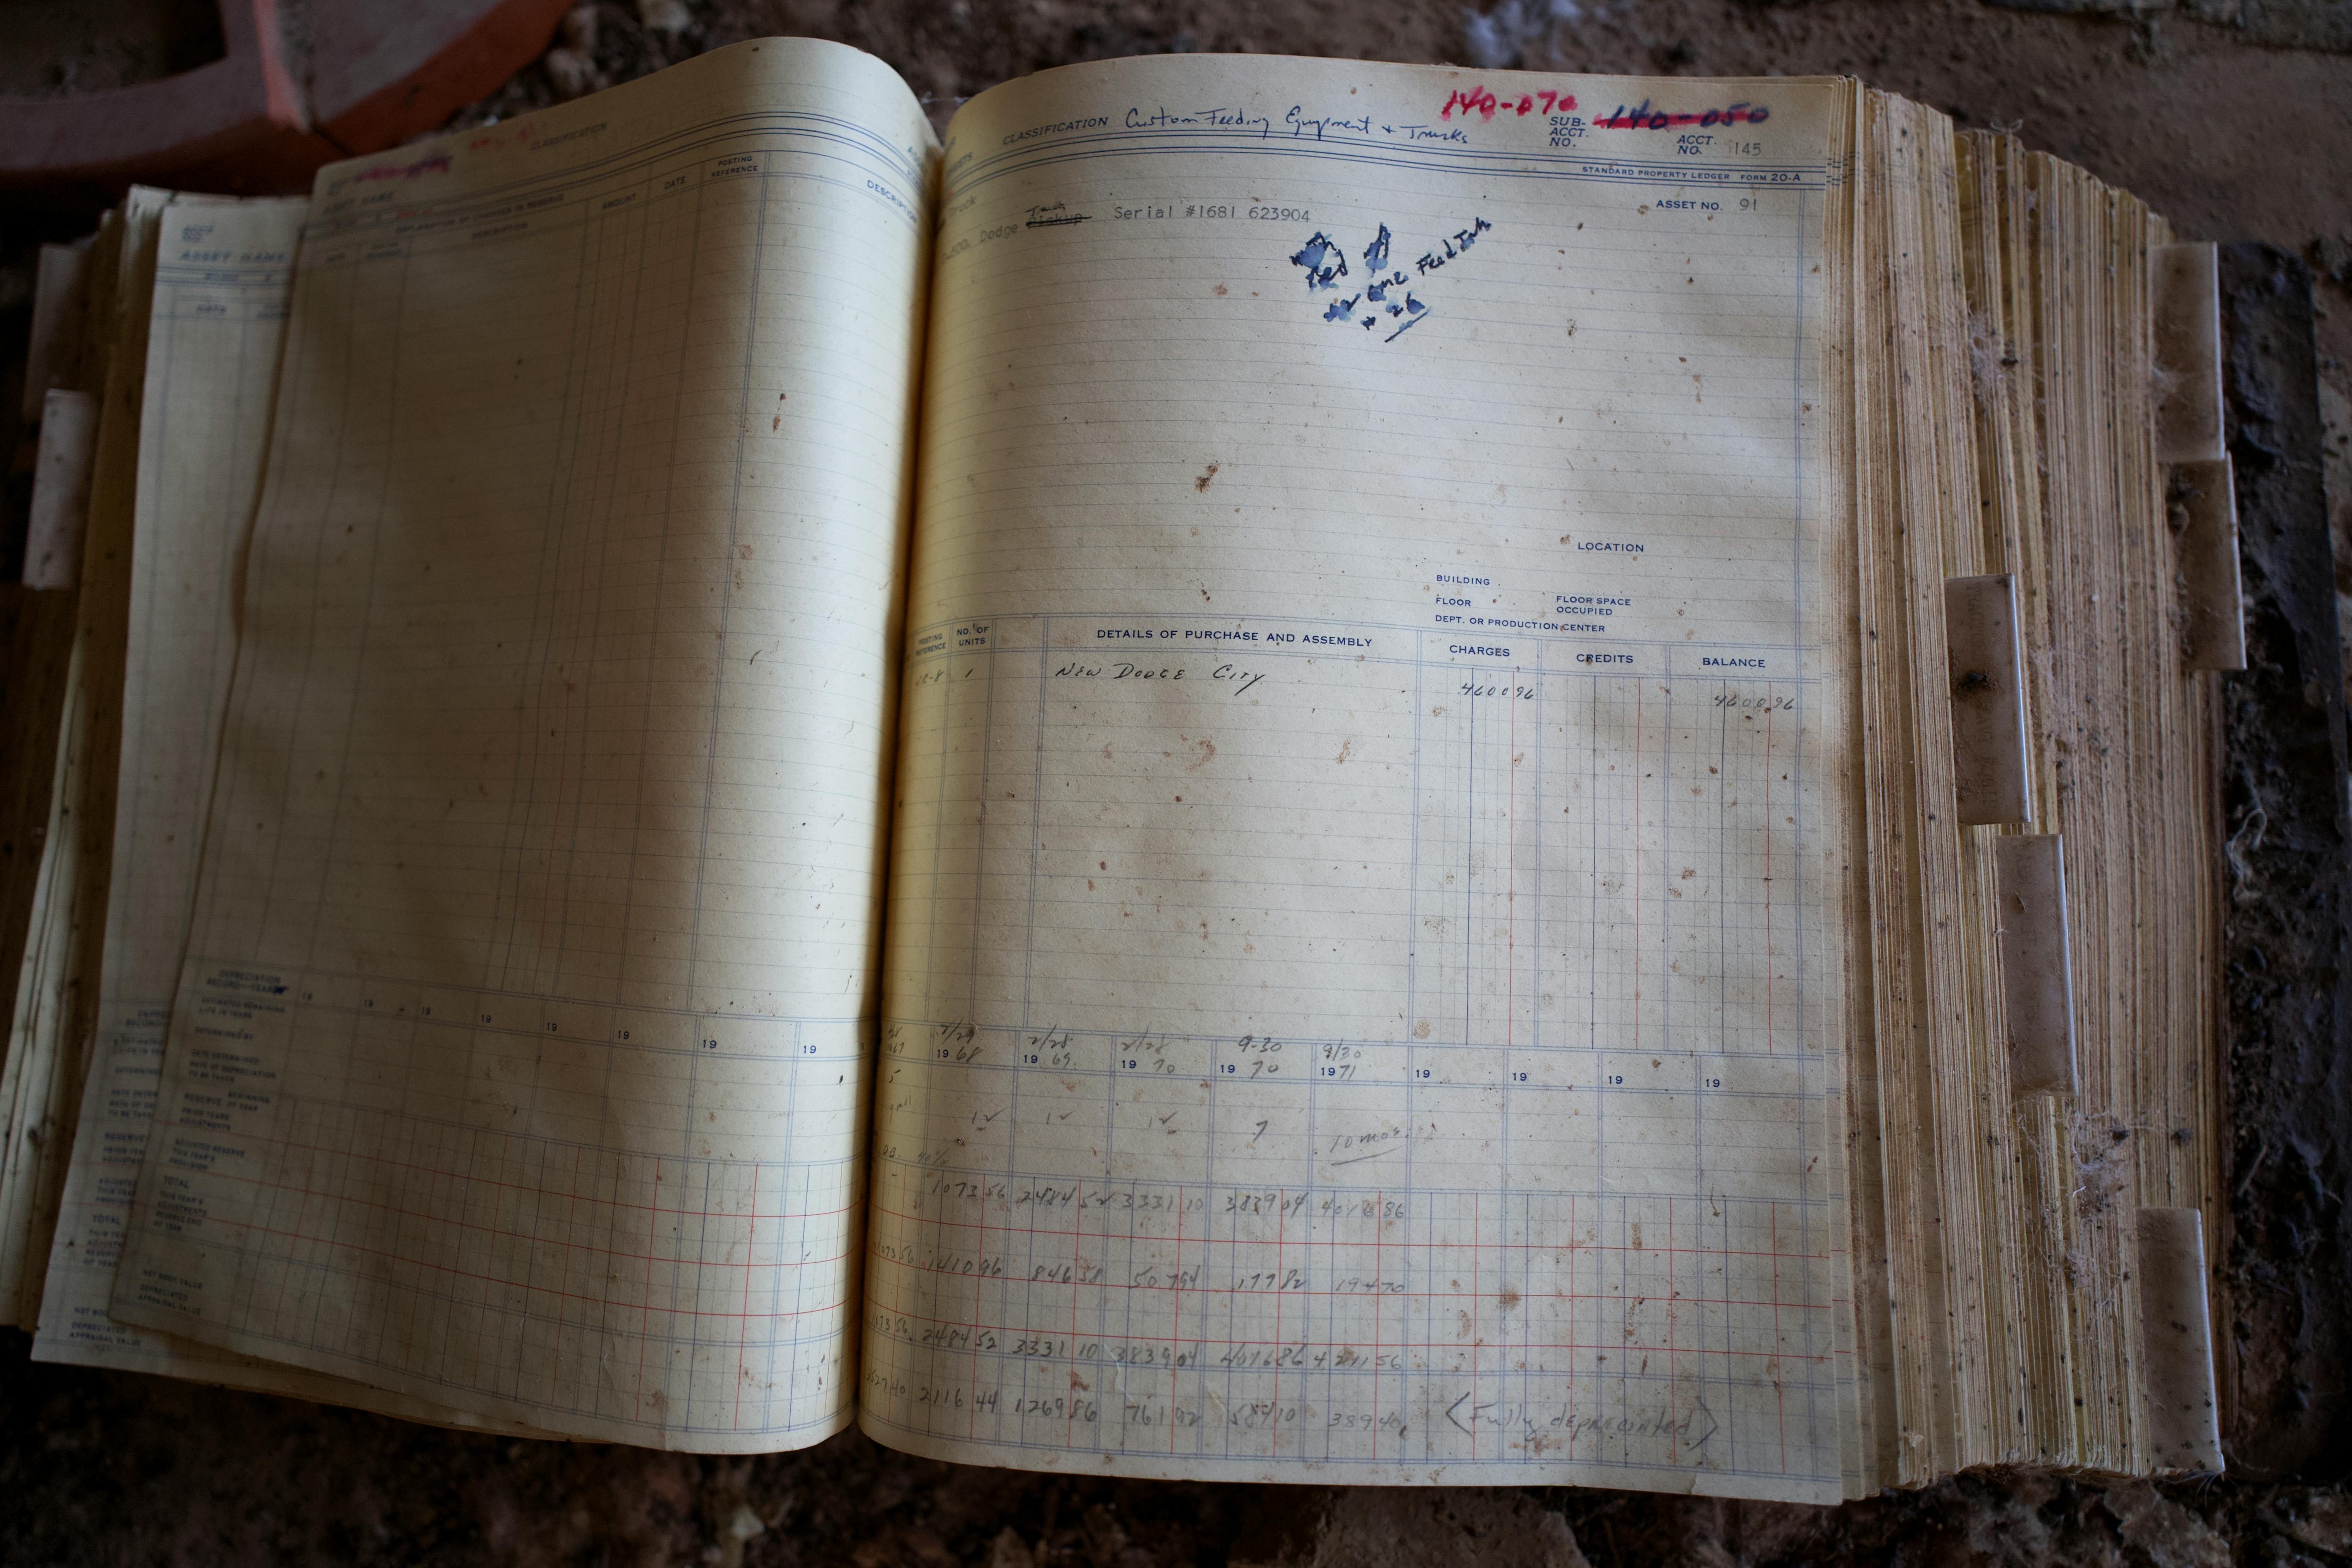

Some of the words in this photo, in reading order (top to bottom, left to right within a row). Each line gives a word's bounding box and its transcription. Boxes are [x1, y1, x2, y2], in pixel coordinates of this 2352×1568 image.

[1125, 107, 1199, 128] Custom
[1194, 107, 1269, 139] Feeding
[1400, 125, 1468, 144] Trucks
[1549, 116, 1587, 126] SUB-
[1004, 116, 1109, 145] CLASSIFICATION
[1549, 128, 1589, 138] ACCT.
[1549, 138, 1576, 147] NO.
[1676, 135, 1717, 145] ACCT.
[1677, 145, 1703, 155] NO.
[1733, 143, 1762, 156] 145
[717, 155, 753, 167] POSTING
[711, 165, 759, 177] REFERENCE
[1582, 166, 1635, 176] STANDARD
[1638, 169, 1688, 179] PROPERTY
[1691, 172, 1730, 181] LEDGER
[1740, 173, 1768, 182] FORM
[1770, 172, 1801, 182] 20-A
[663, 175, 686, 190] DATE
[601, 194, 637, 210] AMOUNT
[867, 179, 918, 224] DESCRIPTION
[1656, 200, 1697, 210] ASSET
[1700, 201, 1723, 211] NO.
[1739, 198, 1758, 211] 91
[979, 224, 1018, 243] Dodge
[1114, 205, 1173, 220] Serial
[1185, 205, 1236, 219] #1681
[1248, 207, 1311, 223] 623904
[1577, 542, 1645, 553] LOCATION
[1436, 575, 1491, 586] BUILDING
[1436, 597, 1472, 607] FLOOR
[1556, 595, 1592, 605] FLOOR
[1592, 597, 1631, 607] SPACE
[1556, 606, 1613, 616] OCCUPIED
[1435, 615, 1465, 625] DEPT.
[1469, 617, 1484, 626] OR
[1487, 619, 1559, 630] PRODUCTION
[1562, 622, 1606, 633] CENTER
[959, 637, 986, 646] UNITS
[1097, 629, 1154, 639] DETAILS
[1160, 630, 1179, 639] OF
[1185, 630, 1260, 641] PURCHASE
[1266, 633, 1295, 643] AND
[1302, 635, 1373, 648] ASSEMBLY
[1449, 645, 1511, 657] CHARGES
[1576, 653, 1634, 664] CREDITS
[1702, 657, 1766, 669] BALANCE
[481, 1014, 492, 1024] 19
[547, 1022, 558, 1032] 19
[617, 1030, 630, 1040] 19
[702, 1039, 717, 1050] 19
[803, 1045, 817, 1055] 19
[937, 1049, 949, 1058] 19
[1023, 1054, 1038, 1064] 19
[1122, 1060, 1137, 1069] 19
[1220, 1064, 1236, 1074] 19
[1321, 1067, 1336, 1076] 19
[1415, 1069, 1431, 1080] 19
[1512, 1072, 1528, 1082] 19
[1608, 1076, 1623, 1085] 19
[1705, 1078, 1721, 1088] 19
